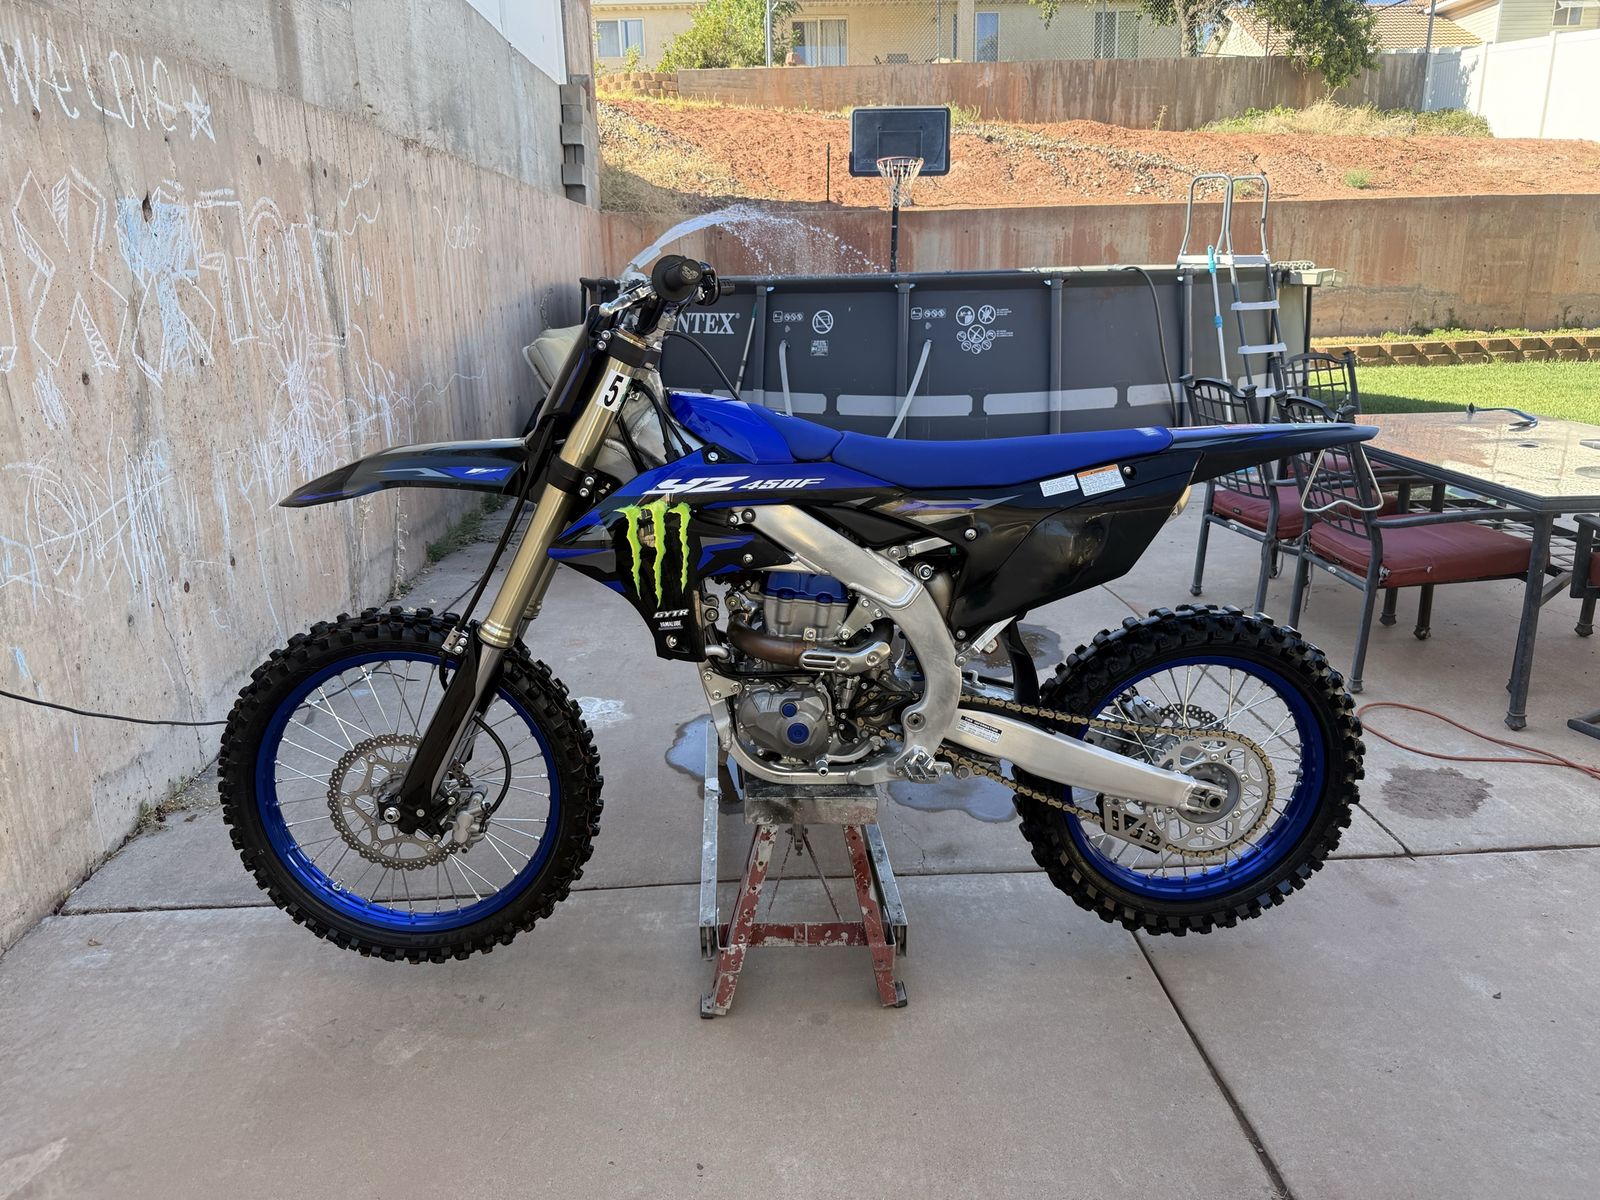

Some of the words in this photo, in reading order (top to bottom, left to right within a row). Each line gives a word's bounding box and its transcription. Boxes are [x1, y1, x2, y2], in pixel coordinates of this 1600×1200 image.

[671, 312, 736, 334] NTEX
[604, 374, 624, 407] 5
[642, 476, 750, 494] YZ
[738, 478, 826, 490] 450F
[653, 609, 689, 619] GYTR
